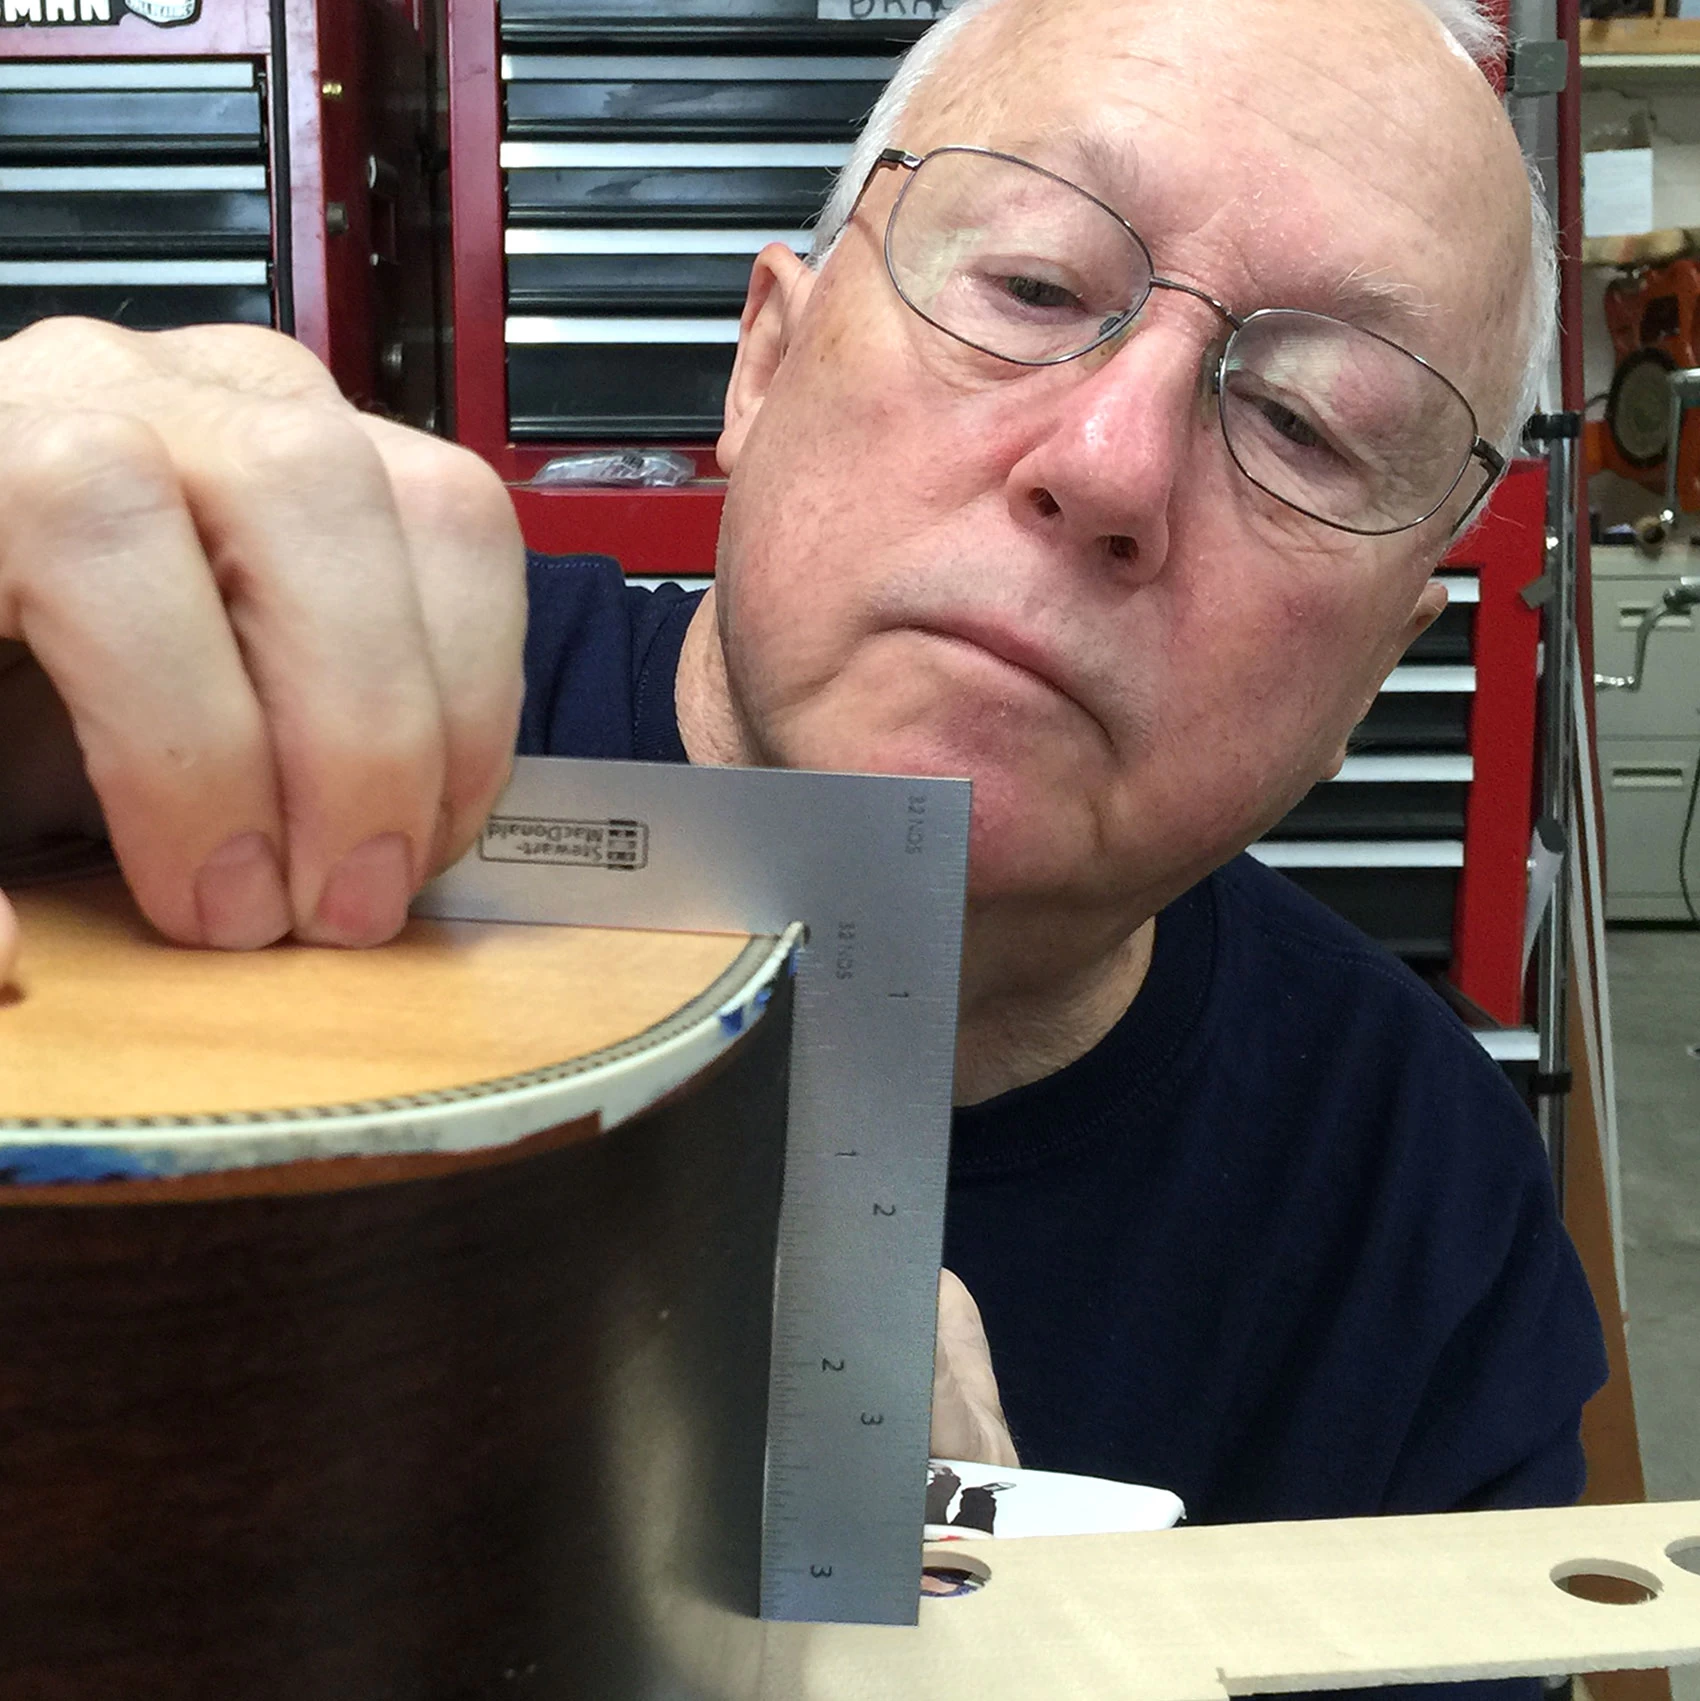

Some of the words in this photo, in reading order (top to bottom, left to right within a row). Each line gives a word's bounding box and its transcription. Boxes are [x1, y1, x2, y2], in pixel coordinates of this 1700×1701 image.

[488, 823, 603, 843] MacDonald
[872, 1202, 896, 1216] 2
[821, 1357, 845, 1372] 2
[860, 1411, 884, 1426] 3
[809, 1564, 833, 1578] 3
